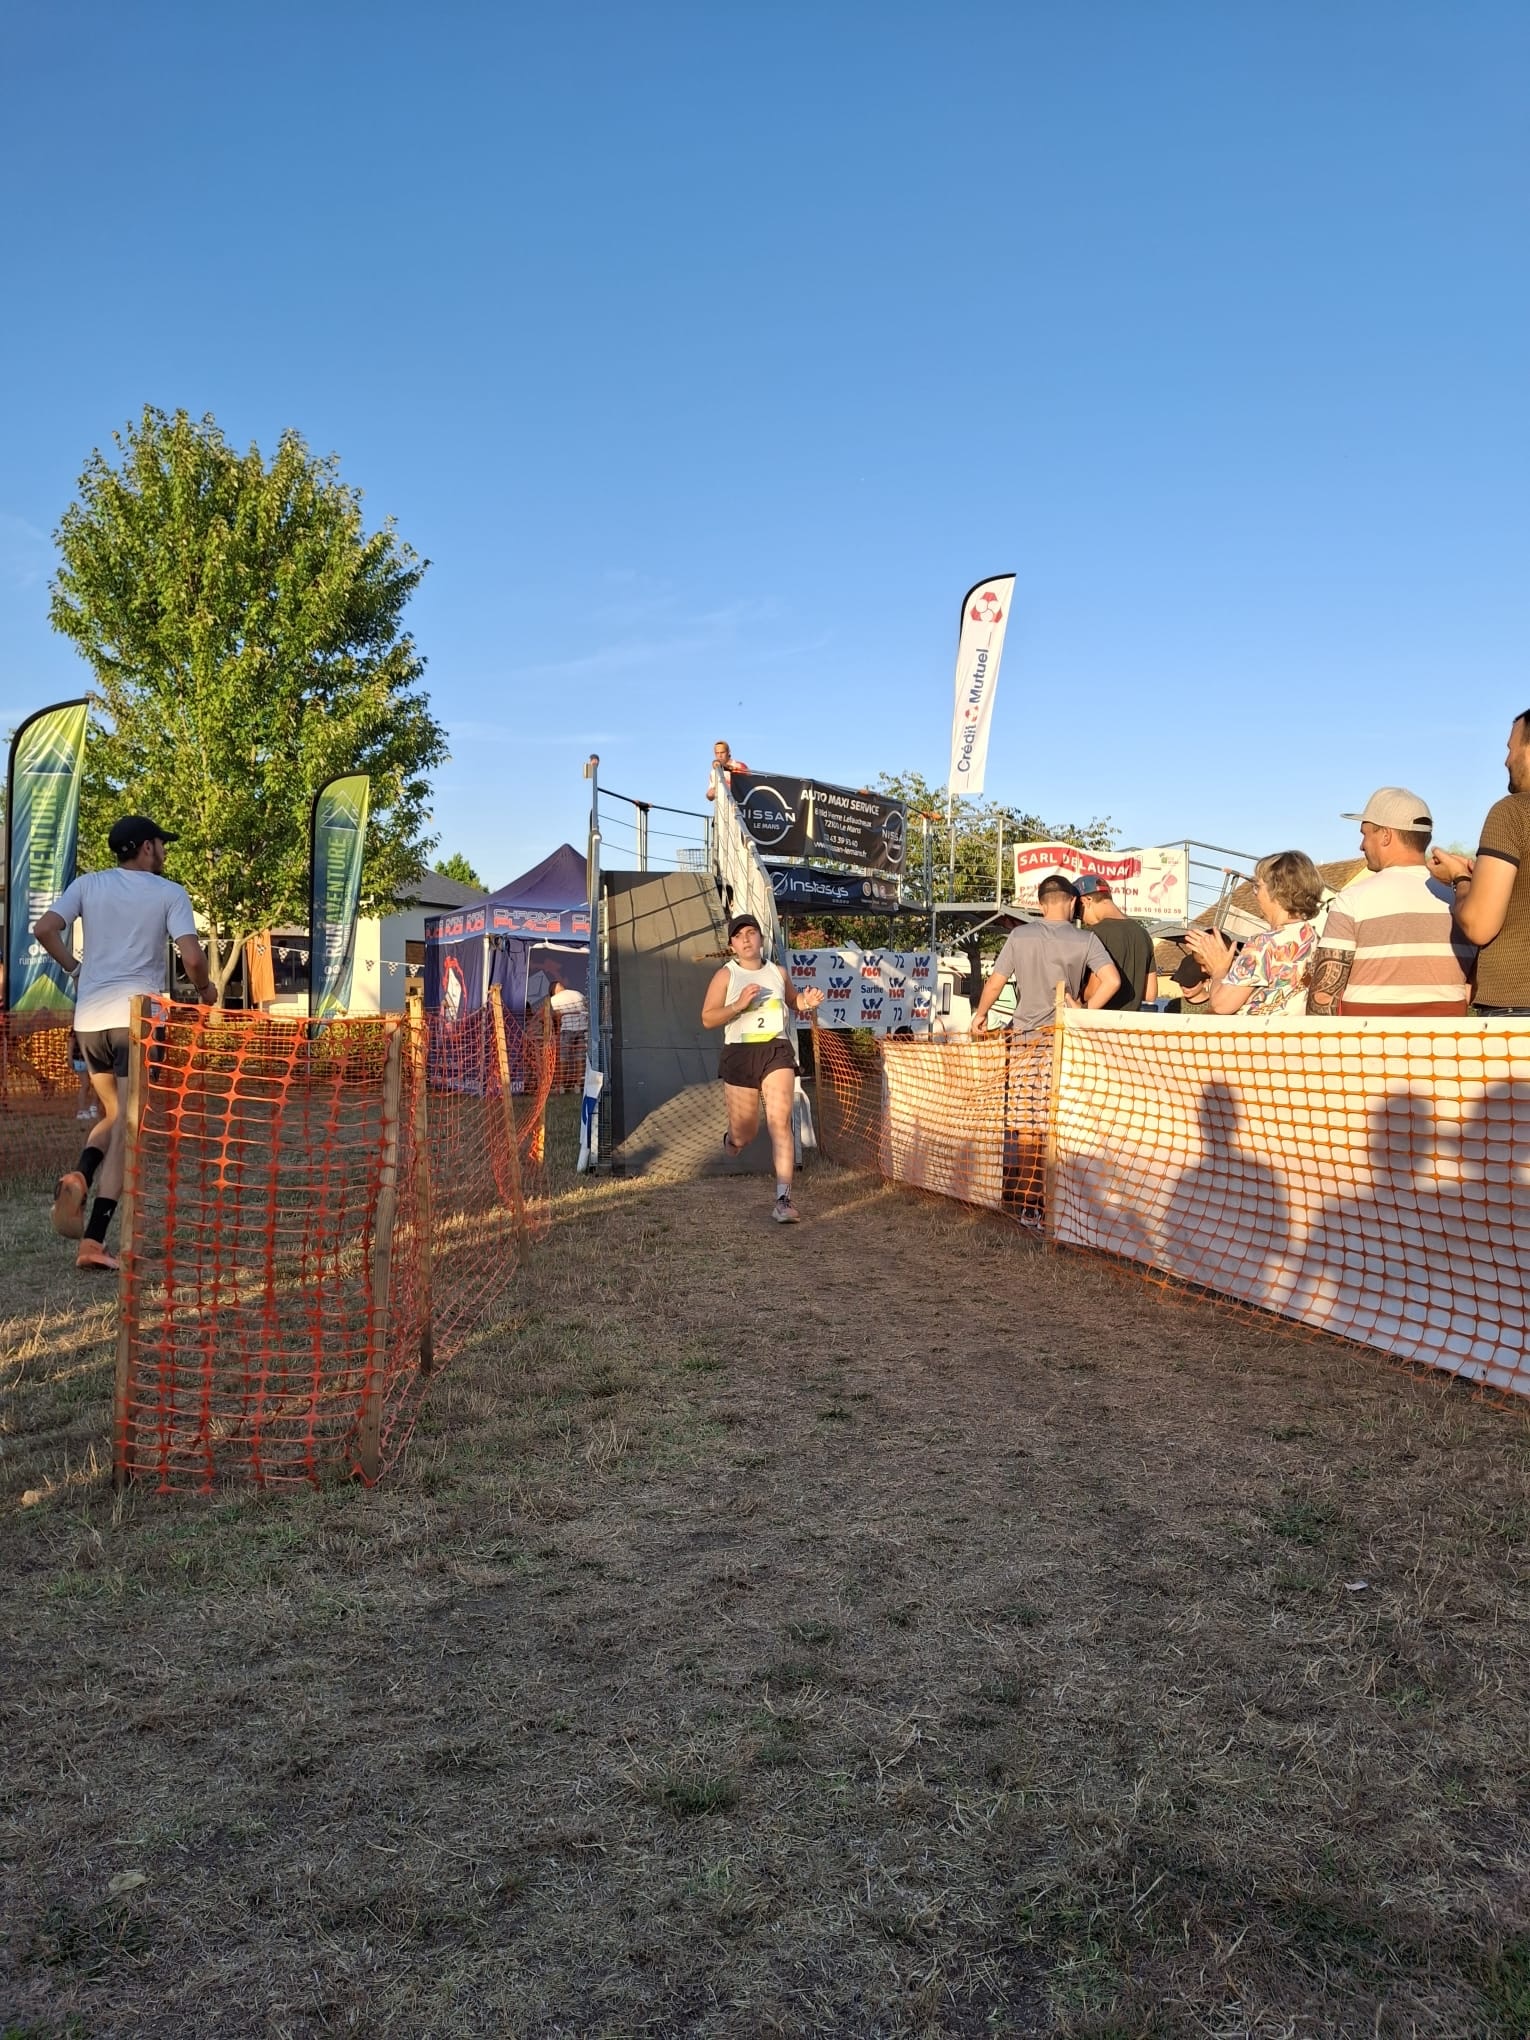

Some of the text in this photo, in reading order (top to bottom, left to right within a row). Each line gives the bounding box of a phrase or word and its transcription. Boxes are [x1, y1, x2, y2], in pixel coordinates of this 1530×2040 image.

[957, 648, 989, 772] Crédit Mutuel
[801, 789, 880, 816] AUTO MAXI SERVICE
[847, 825, 862, 834] Mans
[1019, 852, 1058, 866] SARL
[790, 878, 849, 898] Instasys
[494, 909, 561, 921] CHRONO
[494, 916, 560, 932] PLACE
[830, 955, 845, 969] 72
[894, 954, 905, 968] 72
[791, 966, 816, 977] FSGT
[861, 967, 881, 977] FSGT
[827, 988, 852, 999] FSGT
[860, 984, 883, 994] Sarthe
[794, 1010, 812, 1021] FSG
[833, 1008, 845, 1023] 72
[860, 1009, 881, 1020] FSGT
[894, 1007, 902, 1022] 72
[757, 1017, 765, 1029] 2
